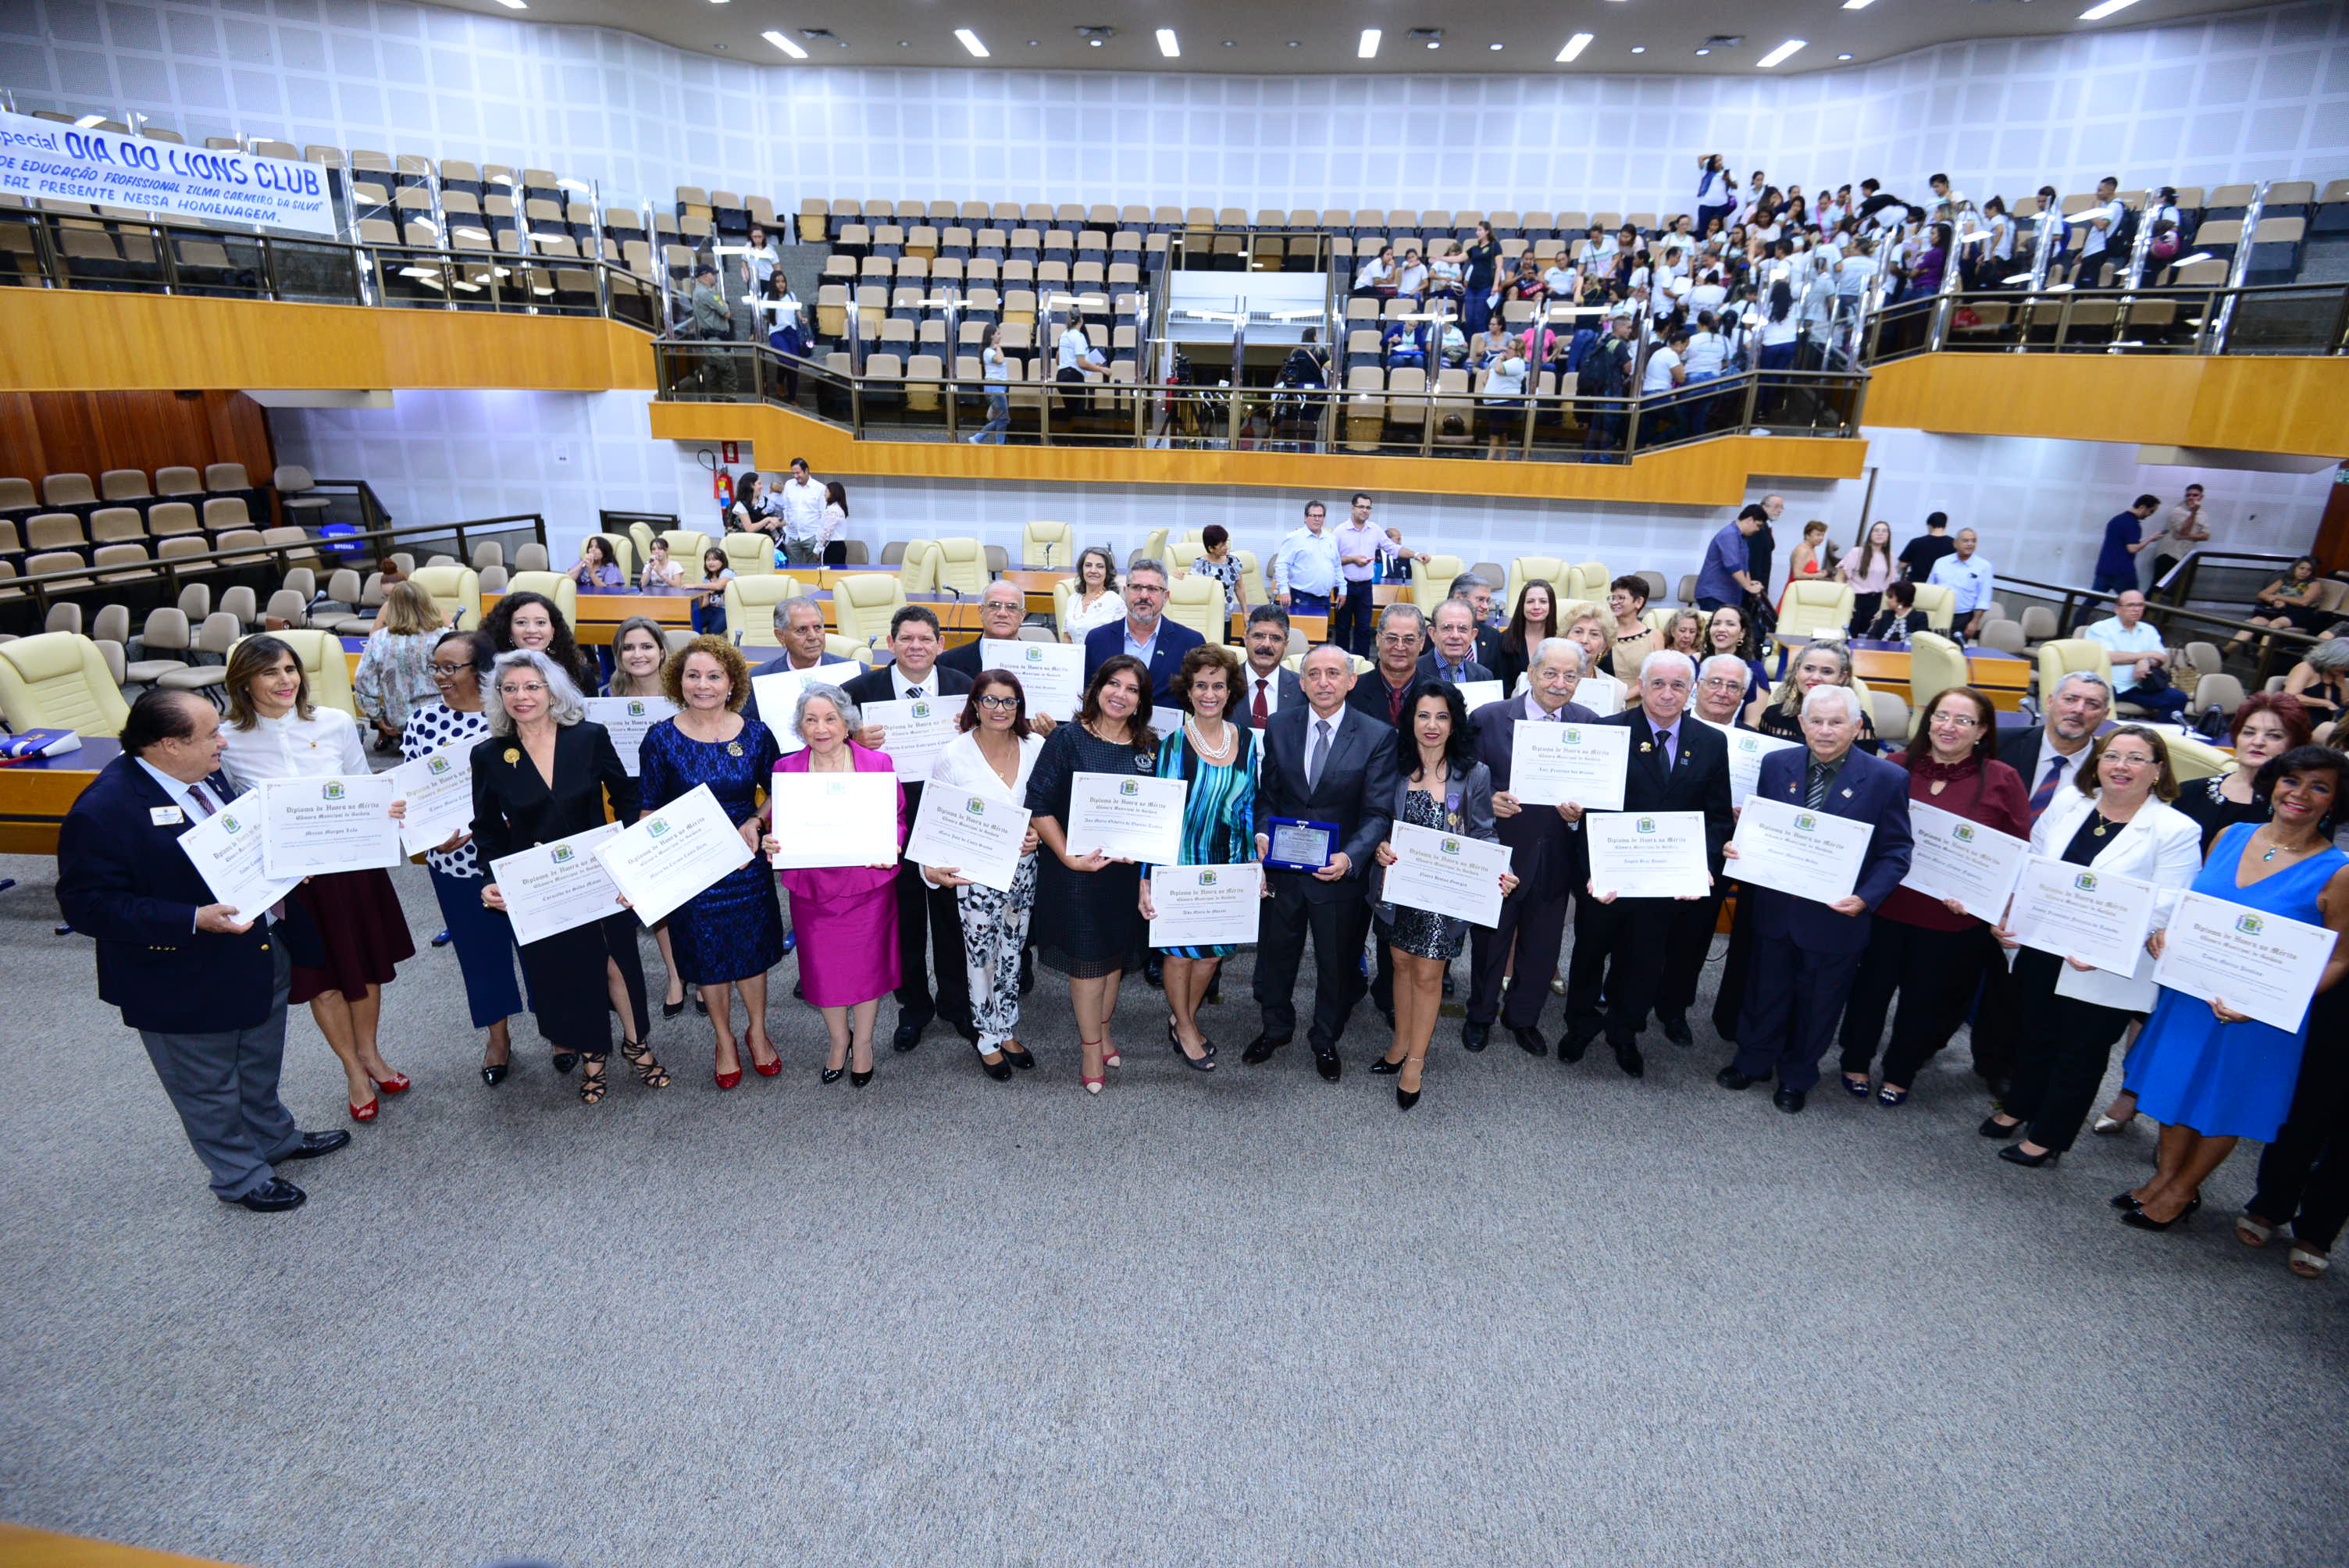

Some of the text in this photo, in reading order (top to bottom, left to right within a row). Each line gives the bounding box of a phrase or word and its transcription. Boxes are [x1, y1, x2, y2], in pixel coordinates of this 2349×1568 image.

[0, 131, 319, 195] pecial DIA DO LIONS CLUB
[21, 159, 98, 180] EDUCAÇÃO
[103, 172, 180, 193] PROFISSIONAL
[186, 184, 220, 198] ZILMA
[223, 191, 273, 205] CARNEIRO
[277, 198, 290, 208] DA
[3, 174, 281, 223] FAZ PRESENTE NESSA HOMENAGEM.
